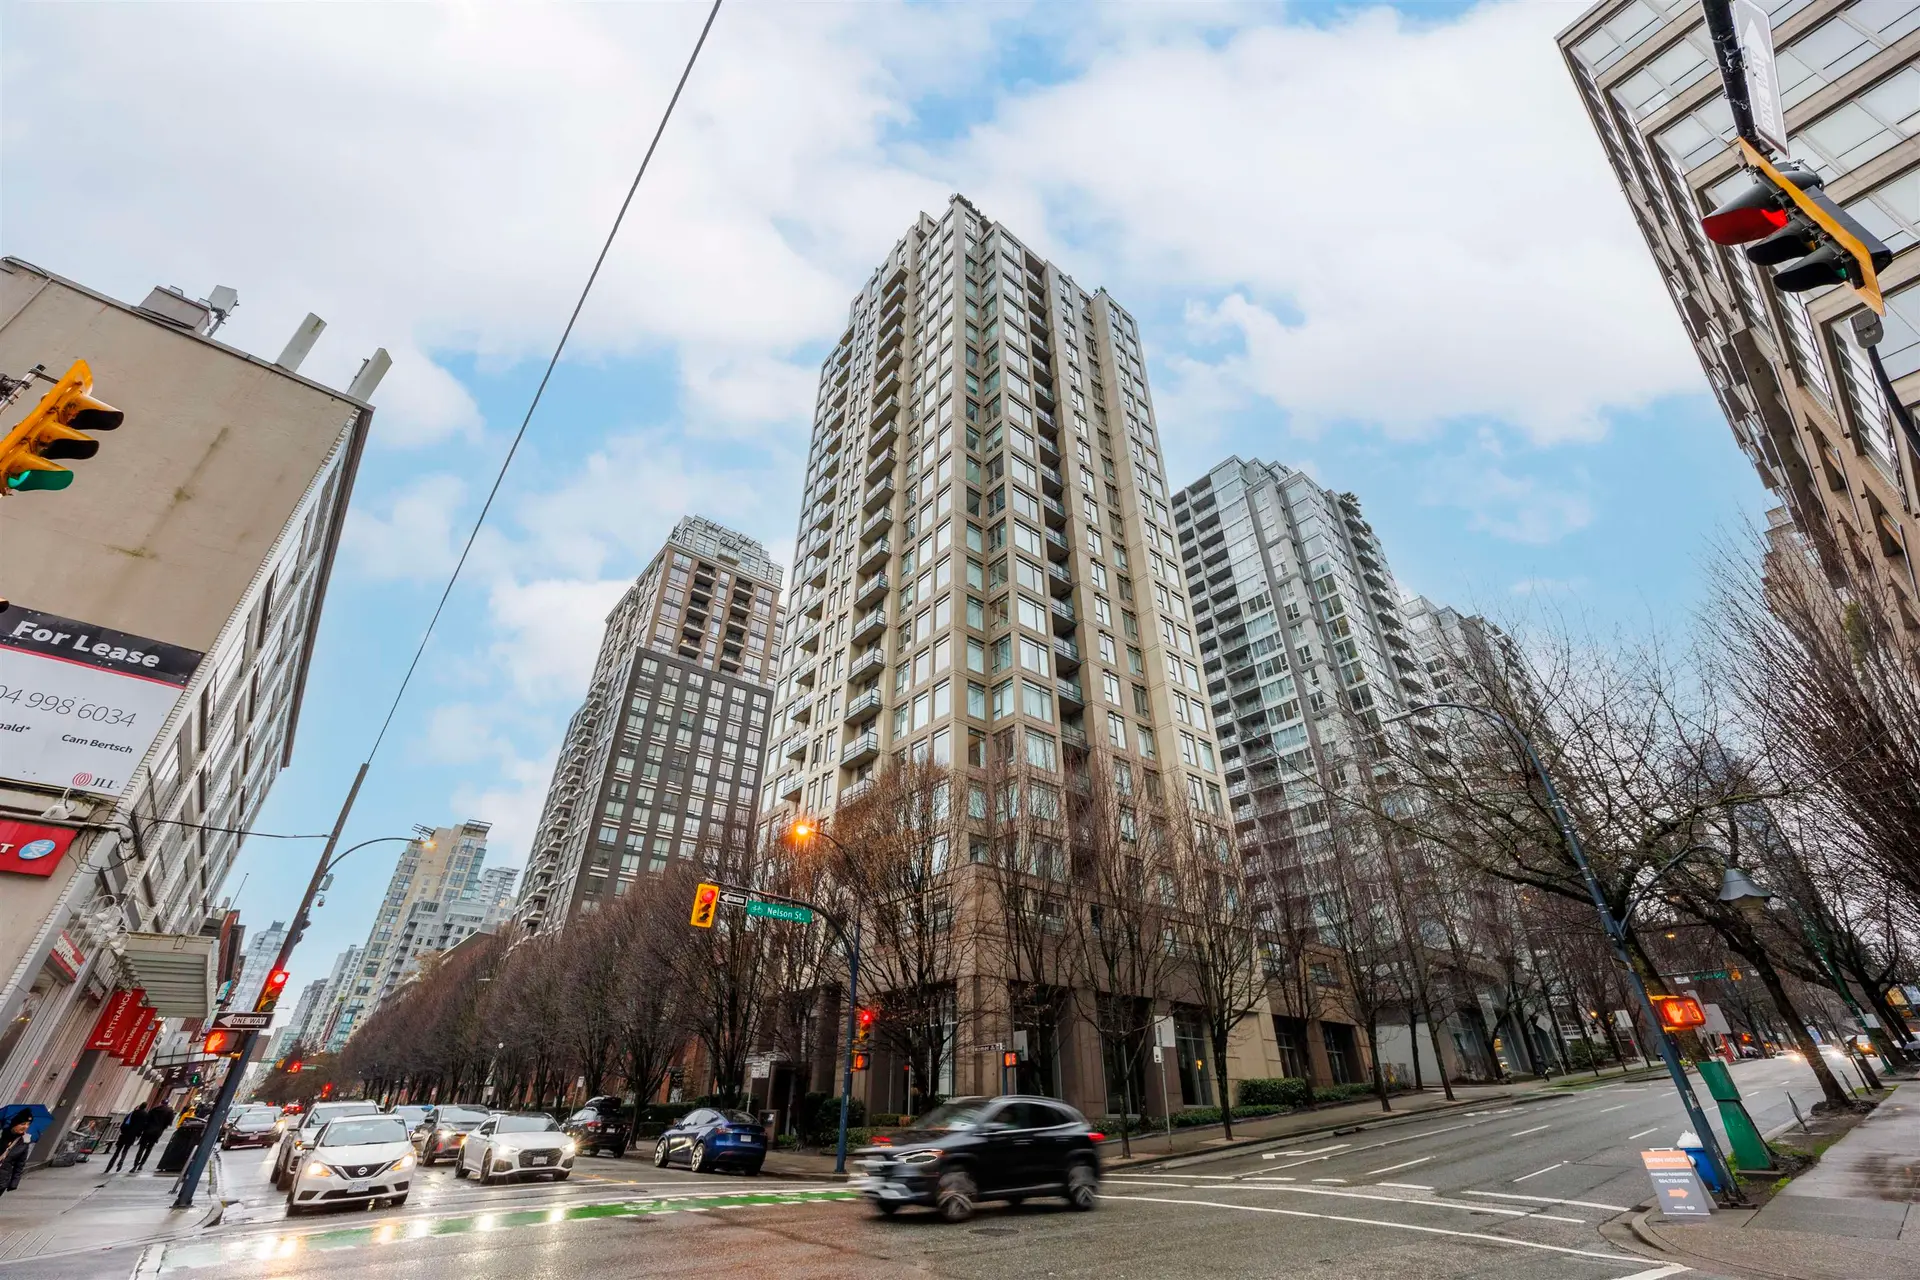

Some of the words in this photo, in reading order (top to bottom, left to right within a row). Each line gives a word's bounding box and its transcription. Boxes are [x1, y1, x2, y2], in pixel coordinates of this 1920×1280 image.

[1751, 52, 1769, 89] WAY
[1760, 100, 1775, 133] ONE
[11, 620, 71, 645] For
[72, 635, 160, 668] Lease
[25, 692, 75, 715] 998
[77, 703, 137, 728] 6034
[61, 734, 88, 746] Cam
[90, 739, 133, 754] Bertsch
[91, 777, 115, 789] JLL
[766, 907, 793, 918] Nelson
[794, 911, 805, 920] St.
[103, 990, 133, 1039] ENTRANCE
[231, 1016, 247, 1024] ONE
[249, 1016, 267, 1024] WAY
